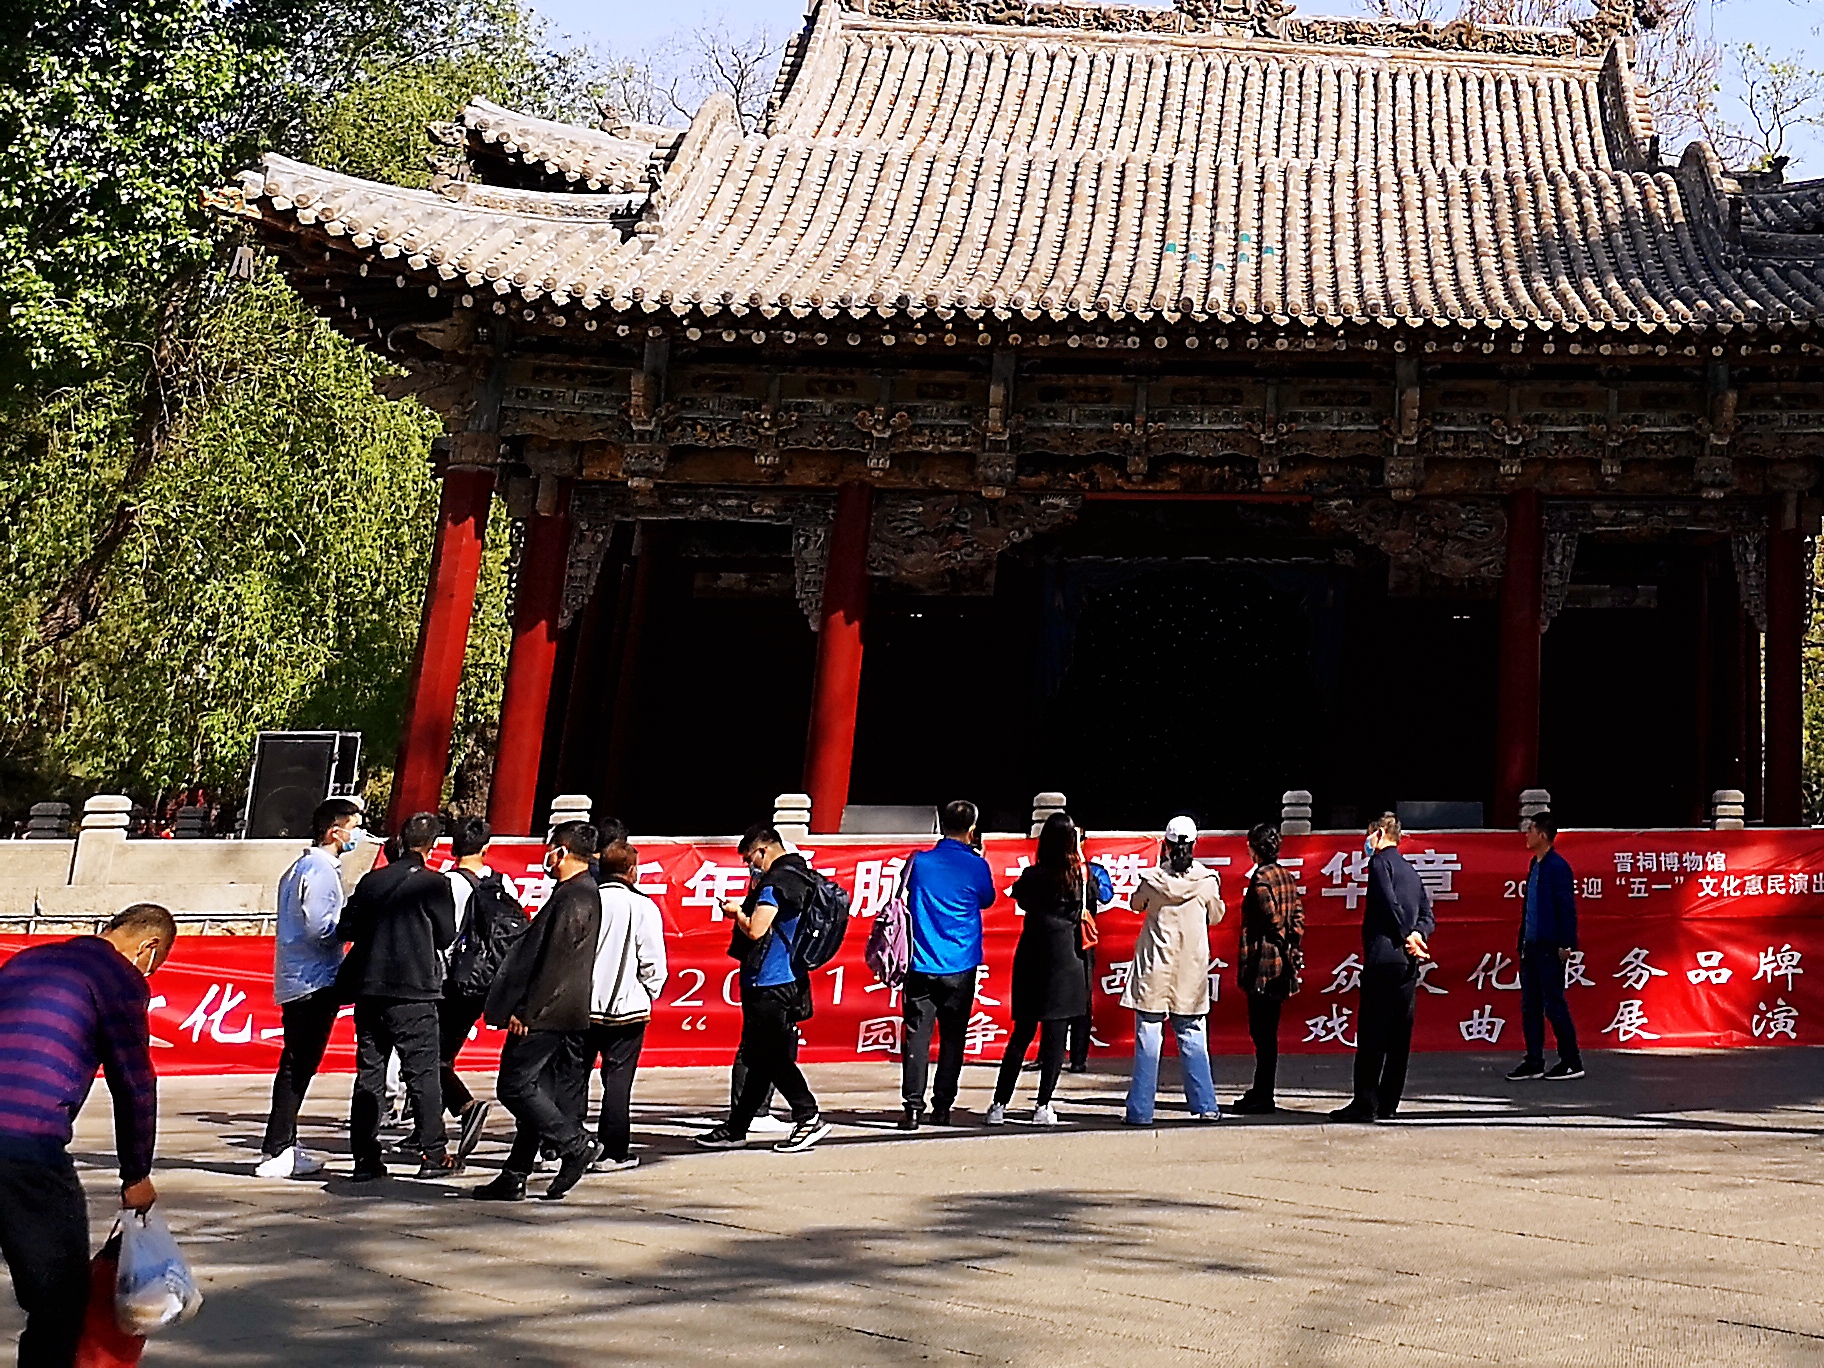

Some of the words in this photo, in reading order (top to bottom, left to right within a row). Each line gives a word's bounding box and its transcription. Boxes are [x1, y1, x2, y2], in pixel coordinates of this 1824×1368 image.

[1612, 851, 1728, 874] 晋祠博物馆
